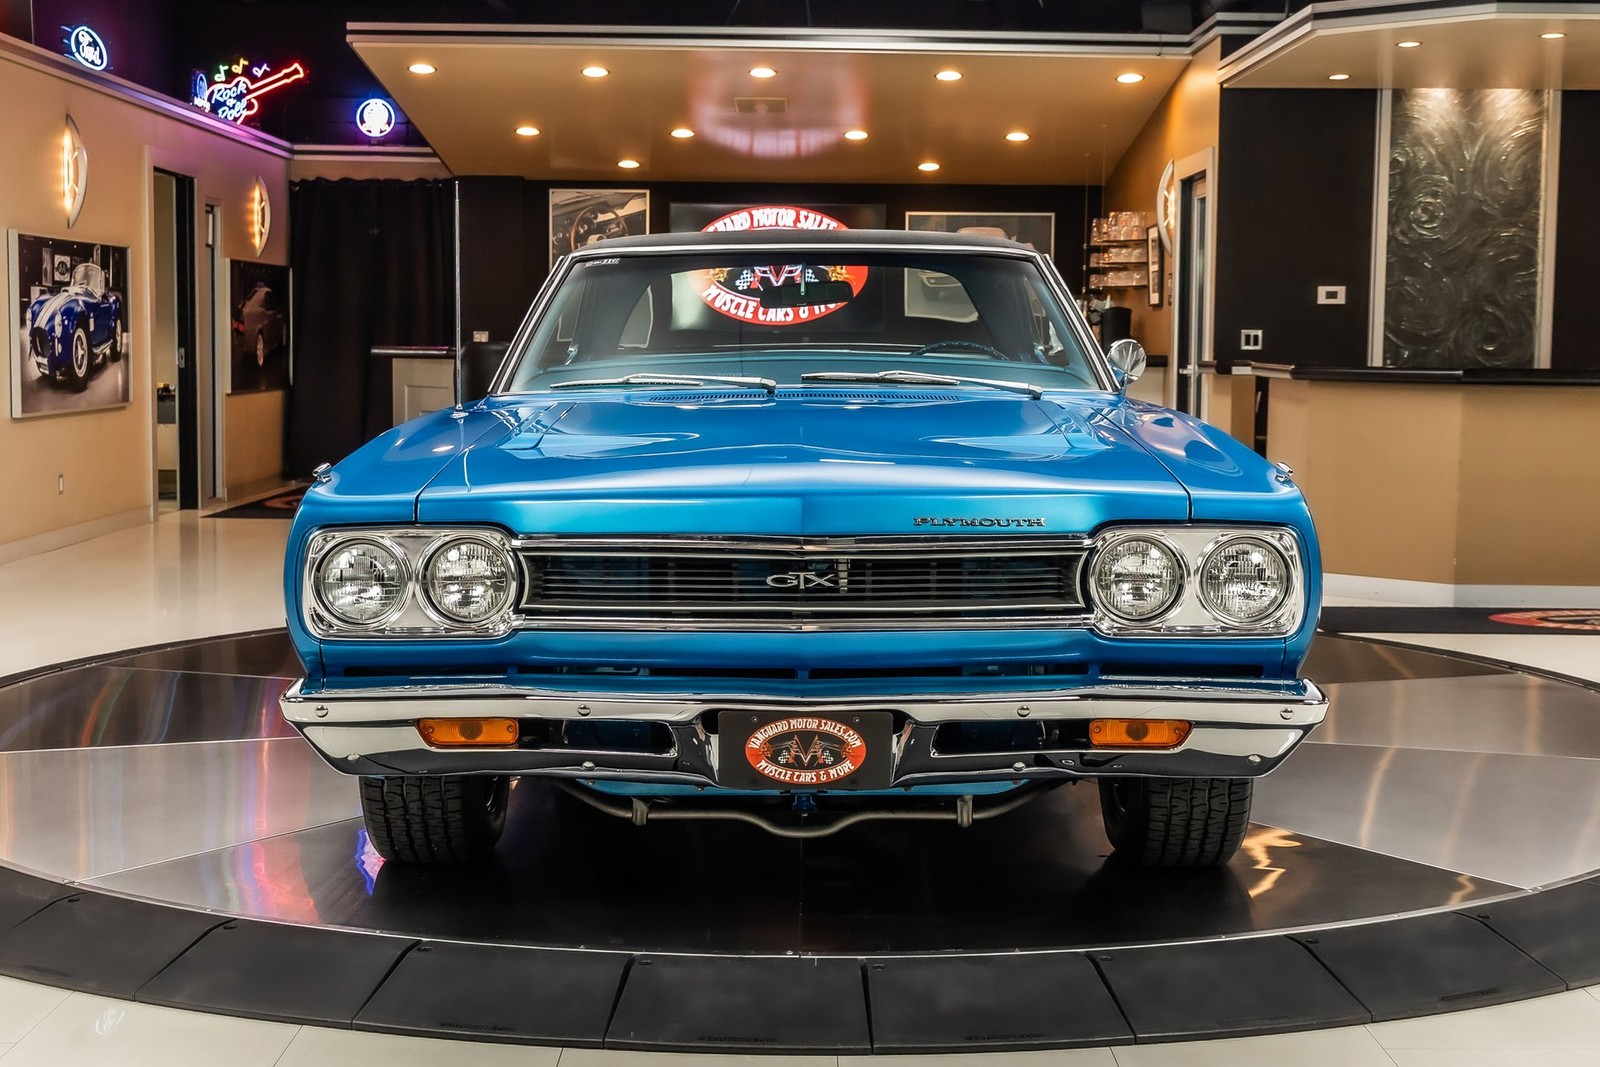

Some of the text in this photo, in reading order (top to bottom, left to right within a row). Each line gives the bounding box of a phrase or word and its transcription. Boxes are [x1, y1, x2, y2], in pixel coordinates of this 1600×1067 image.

[211, 80, 247, 103] Rock
[751, 208, 797, 228] MOTOR
[702, 284, 757, 319] MUSCLE
[913, 517, 1046, 527] PLYMOUTH
[766, 571, 836, 589] GTX
[748, 718, 862, 749] VANGUARD MOTOR SALES.COM
[756, 760, 855, 783] MUSCLE CARS & MORE
